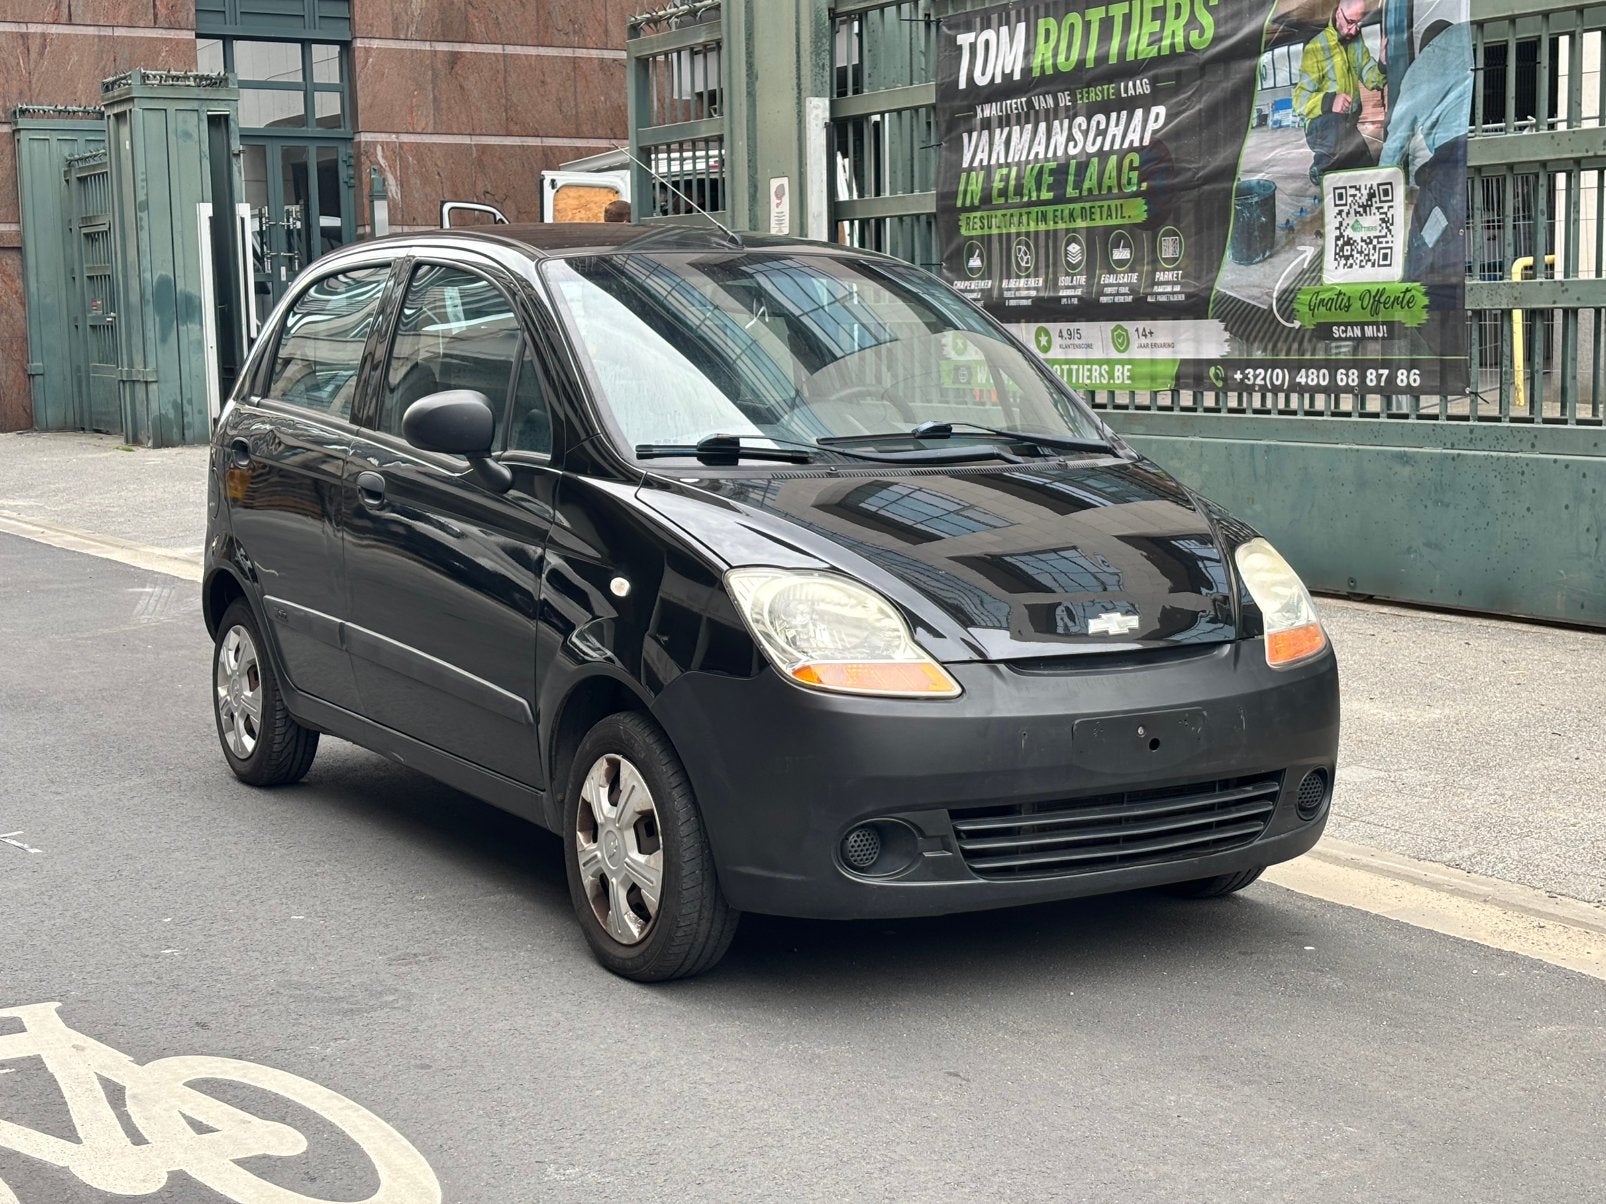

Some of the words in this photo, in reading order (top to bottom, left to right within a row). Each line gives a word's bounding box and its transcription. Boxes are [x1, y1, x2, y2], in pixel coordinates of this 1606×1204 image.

[956, 22, 1026, 89] TOM
[1032, 0, 1218, 77] ROTTIERS
[975, 97, 1027, 119] KWALITEIT
[1032, 94, 1054, 110] VAN
[1058, 91, 1072, 106] DE
[1075, 84, 1116, 104] EERSTE
[1120, 79, 1150, 98] LAAG
[961, 105, 1167, 168] VAKMANSCHAP
[956, 170, 986, 207] IN
[991, 162, 1058, 205] ELKE
[1065, 151, 1148, 198] LAAG.
[964, 211, 1032, 232] RESULTAAT
[1035, 209, 1048, 226] IN
[1052, 207, 1077, 224] ELK
[1080, 203, 1132, 223] DETAIL.
[1058, 275, 1087, 286] ISOLATIE
[1100, 272, 1139, 284] EGALISATIE
[1155, 270, 1183, 282] PARKET
[1308, 291, 1352, 318] Gratis
[1359, 287, 1416, 318] Offerte
[1058, 328, 1082, 341] 4.9/5
[1135, 327, 1154, 341] 14+
[1332, 326, 1361, 338] SCAN
[1364, 325, 1388, 338] MIJ!
[1233, 369, 1289, 389] +32(0)
[1296, 369, 1329, 386] 480
[1336, 369, 1359, 386] 68
[1366, 369, 1389, 386] 87
[1396, 370, 1421, 387] 86
